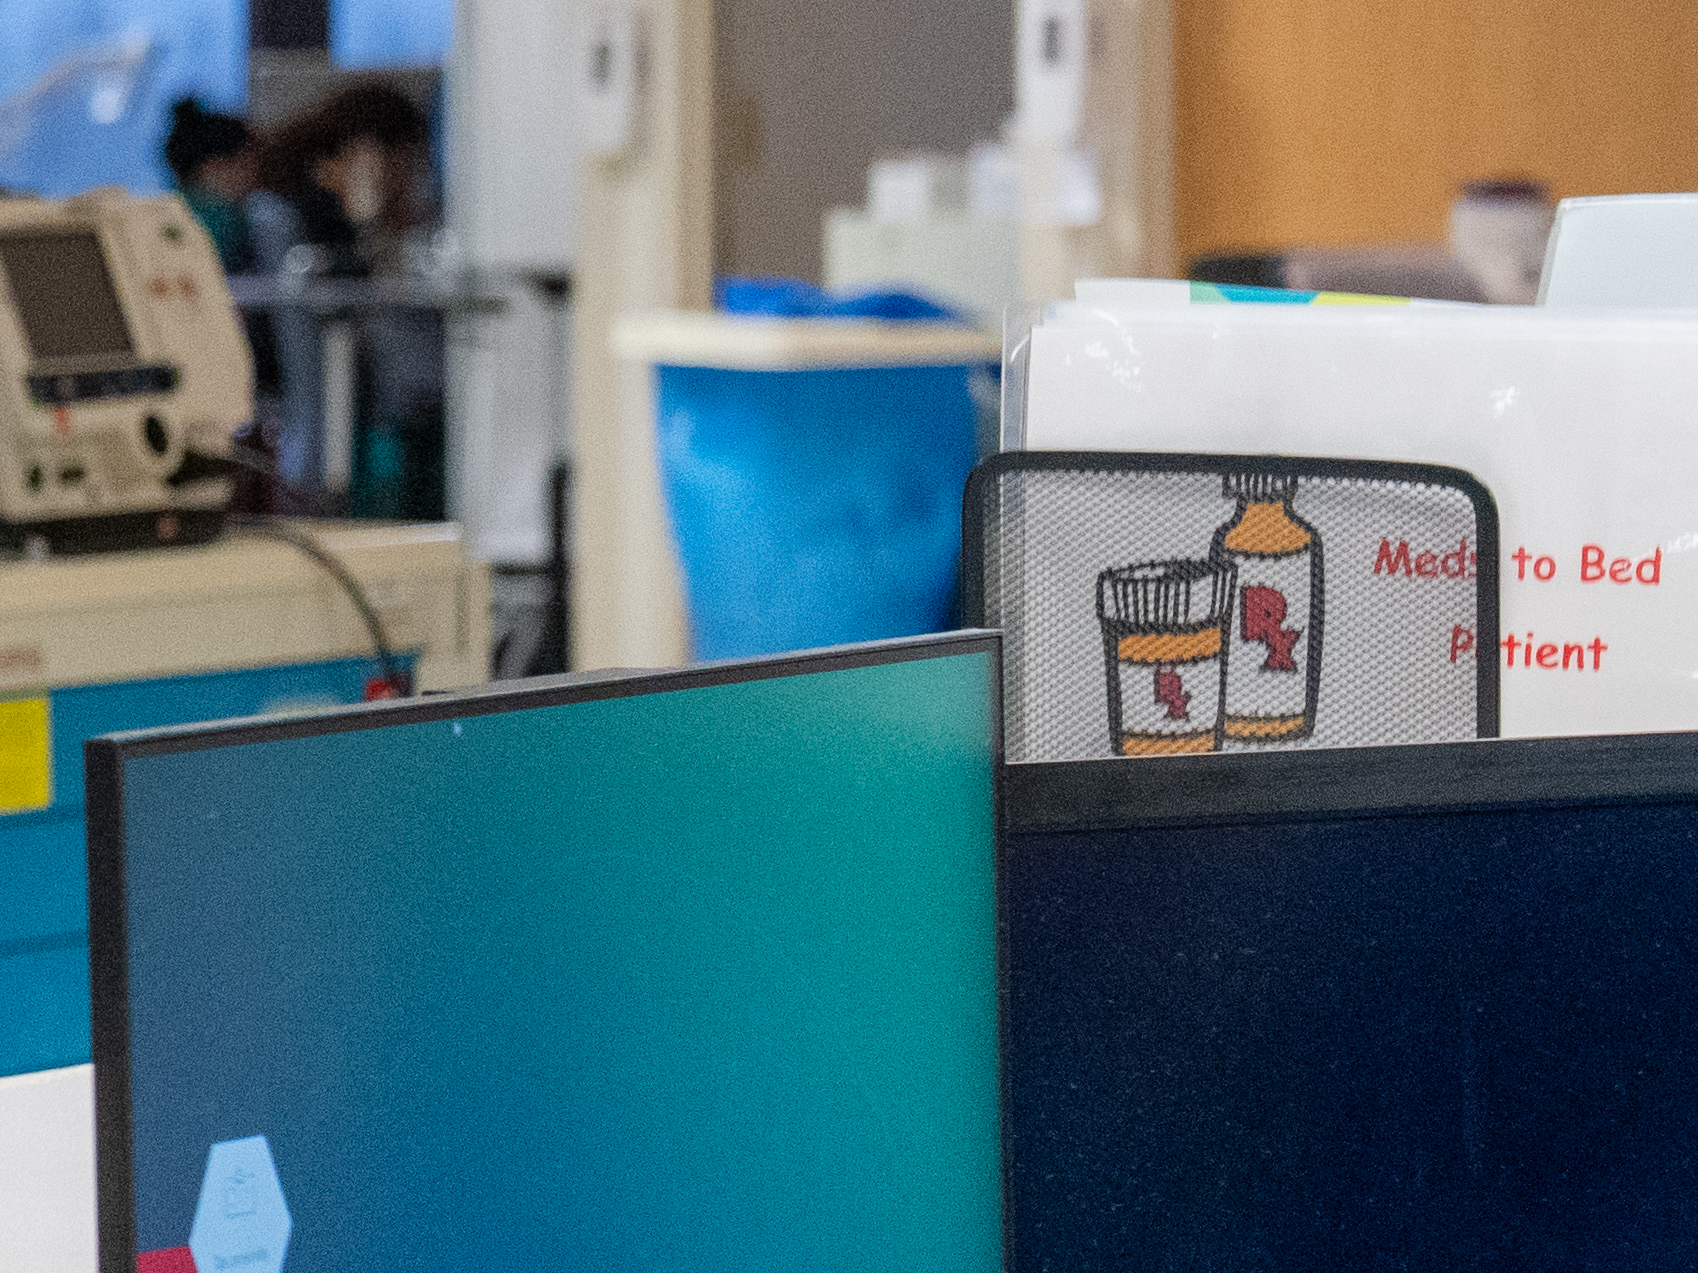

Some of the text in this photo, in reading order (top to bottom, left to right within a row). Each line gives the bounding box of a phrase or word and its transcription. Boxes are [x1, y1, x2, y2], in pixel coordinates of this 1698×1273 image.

[1511, 546, 1557, 582] to
[1580, 544, 1663, 586] Bed
[1450, 624, 1609, 671] Ptient
